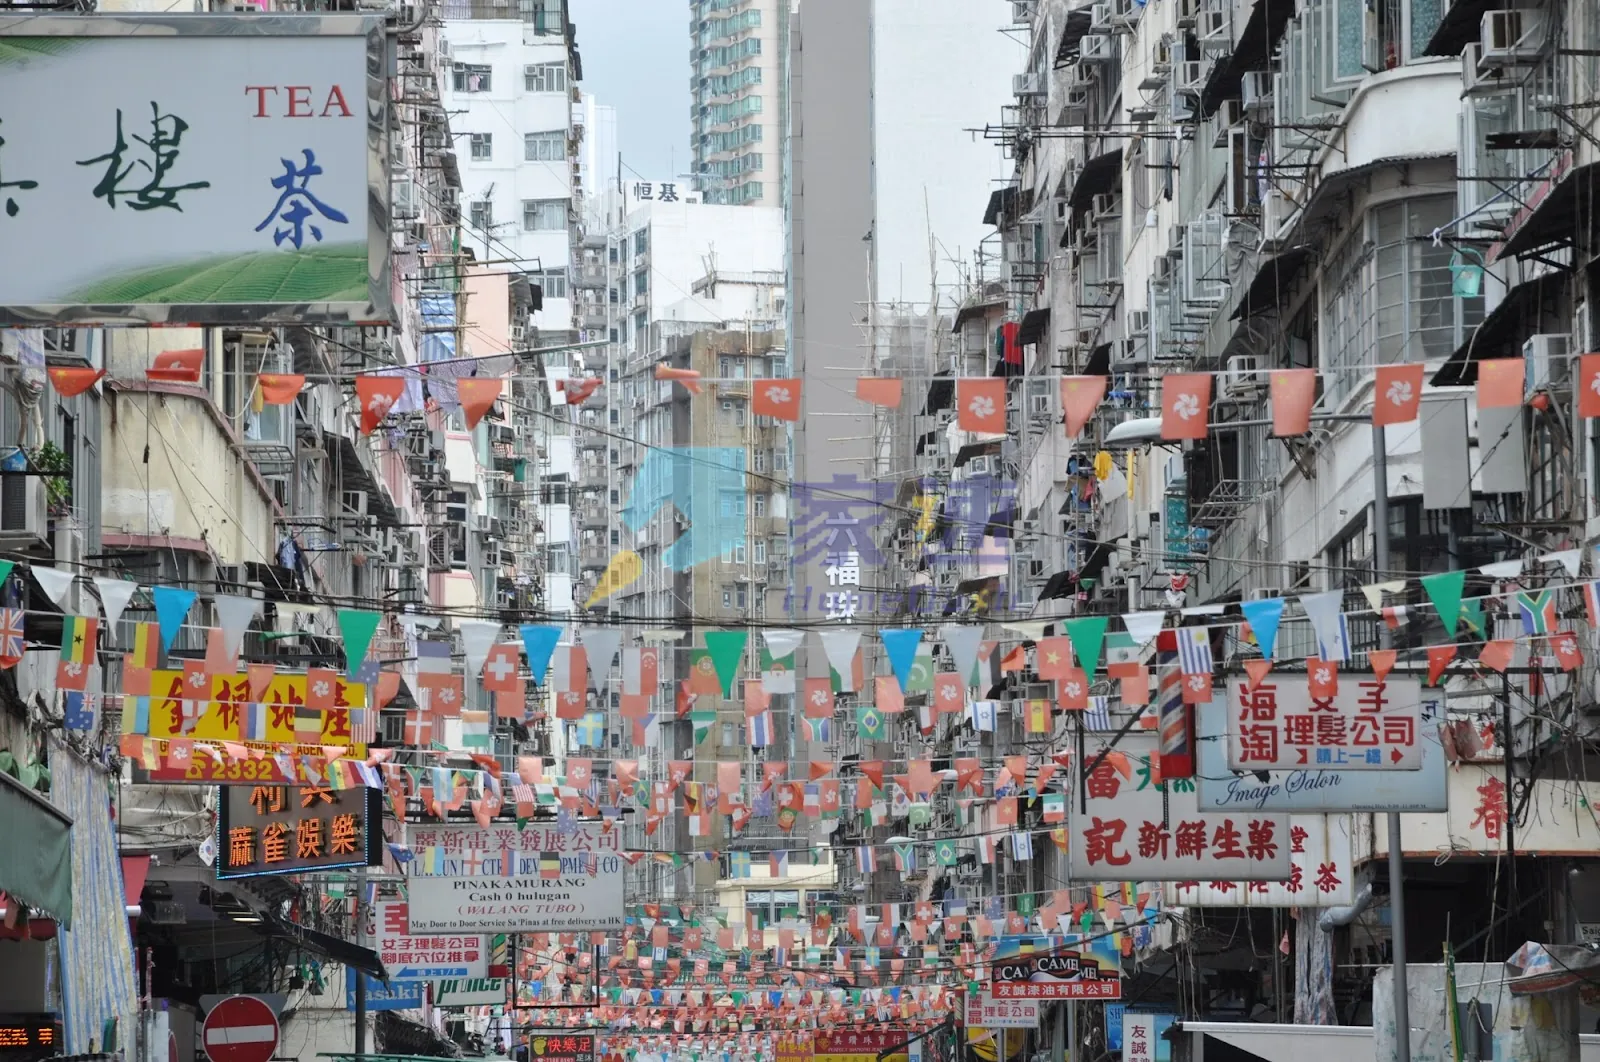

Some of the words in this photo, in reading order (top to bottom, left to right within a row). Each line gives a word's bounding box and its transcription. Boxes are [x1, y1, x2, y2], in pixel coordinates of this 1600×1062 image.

[245, 85, 355, 118] TEA
[255, 149, 349, 250] 茶
[634, 182, 679, 202] 恒基
[825, 512, 859, 623] 六福珠
[1239, 682, 1278, 763] 海淘
[1284, 714, 1414, 746] 理髮公司
[212, 761, 272, 780] 2332
[1215, 777, 1281, 809] Image
[1286, 769, 1342, 798] Salon
[414, 828, 620, 855] 麗新電業發展公司
[1138, 819, 1278, 860] 新鮮生菓
[453, 879, 586, 890] PINAKAMURANG
[469, 892, 500, 901] Cash
[517, 892, 570, 903] hulugan
[411, 921, 427, 929] May
[430, 920, 447, 928] Door
[459, 919, 476, 928] Door
[479, 919, 505, 927] Service
[551, 918, 565, 926] free
[568, 917, 596, 927] delivery
[608, 917, 621, 925] HK
[381, 937, 479, 950] 女子理髮公司
[1037, 958, 1079, 971] CAMEL
[548, 1036, 591, 1053] 快樂足
